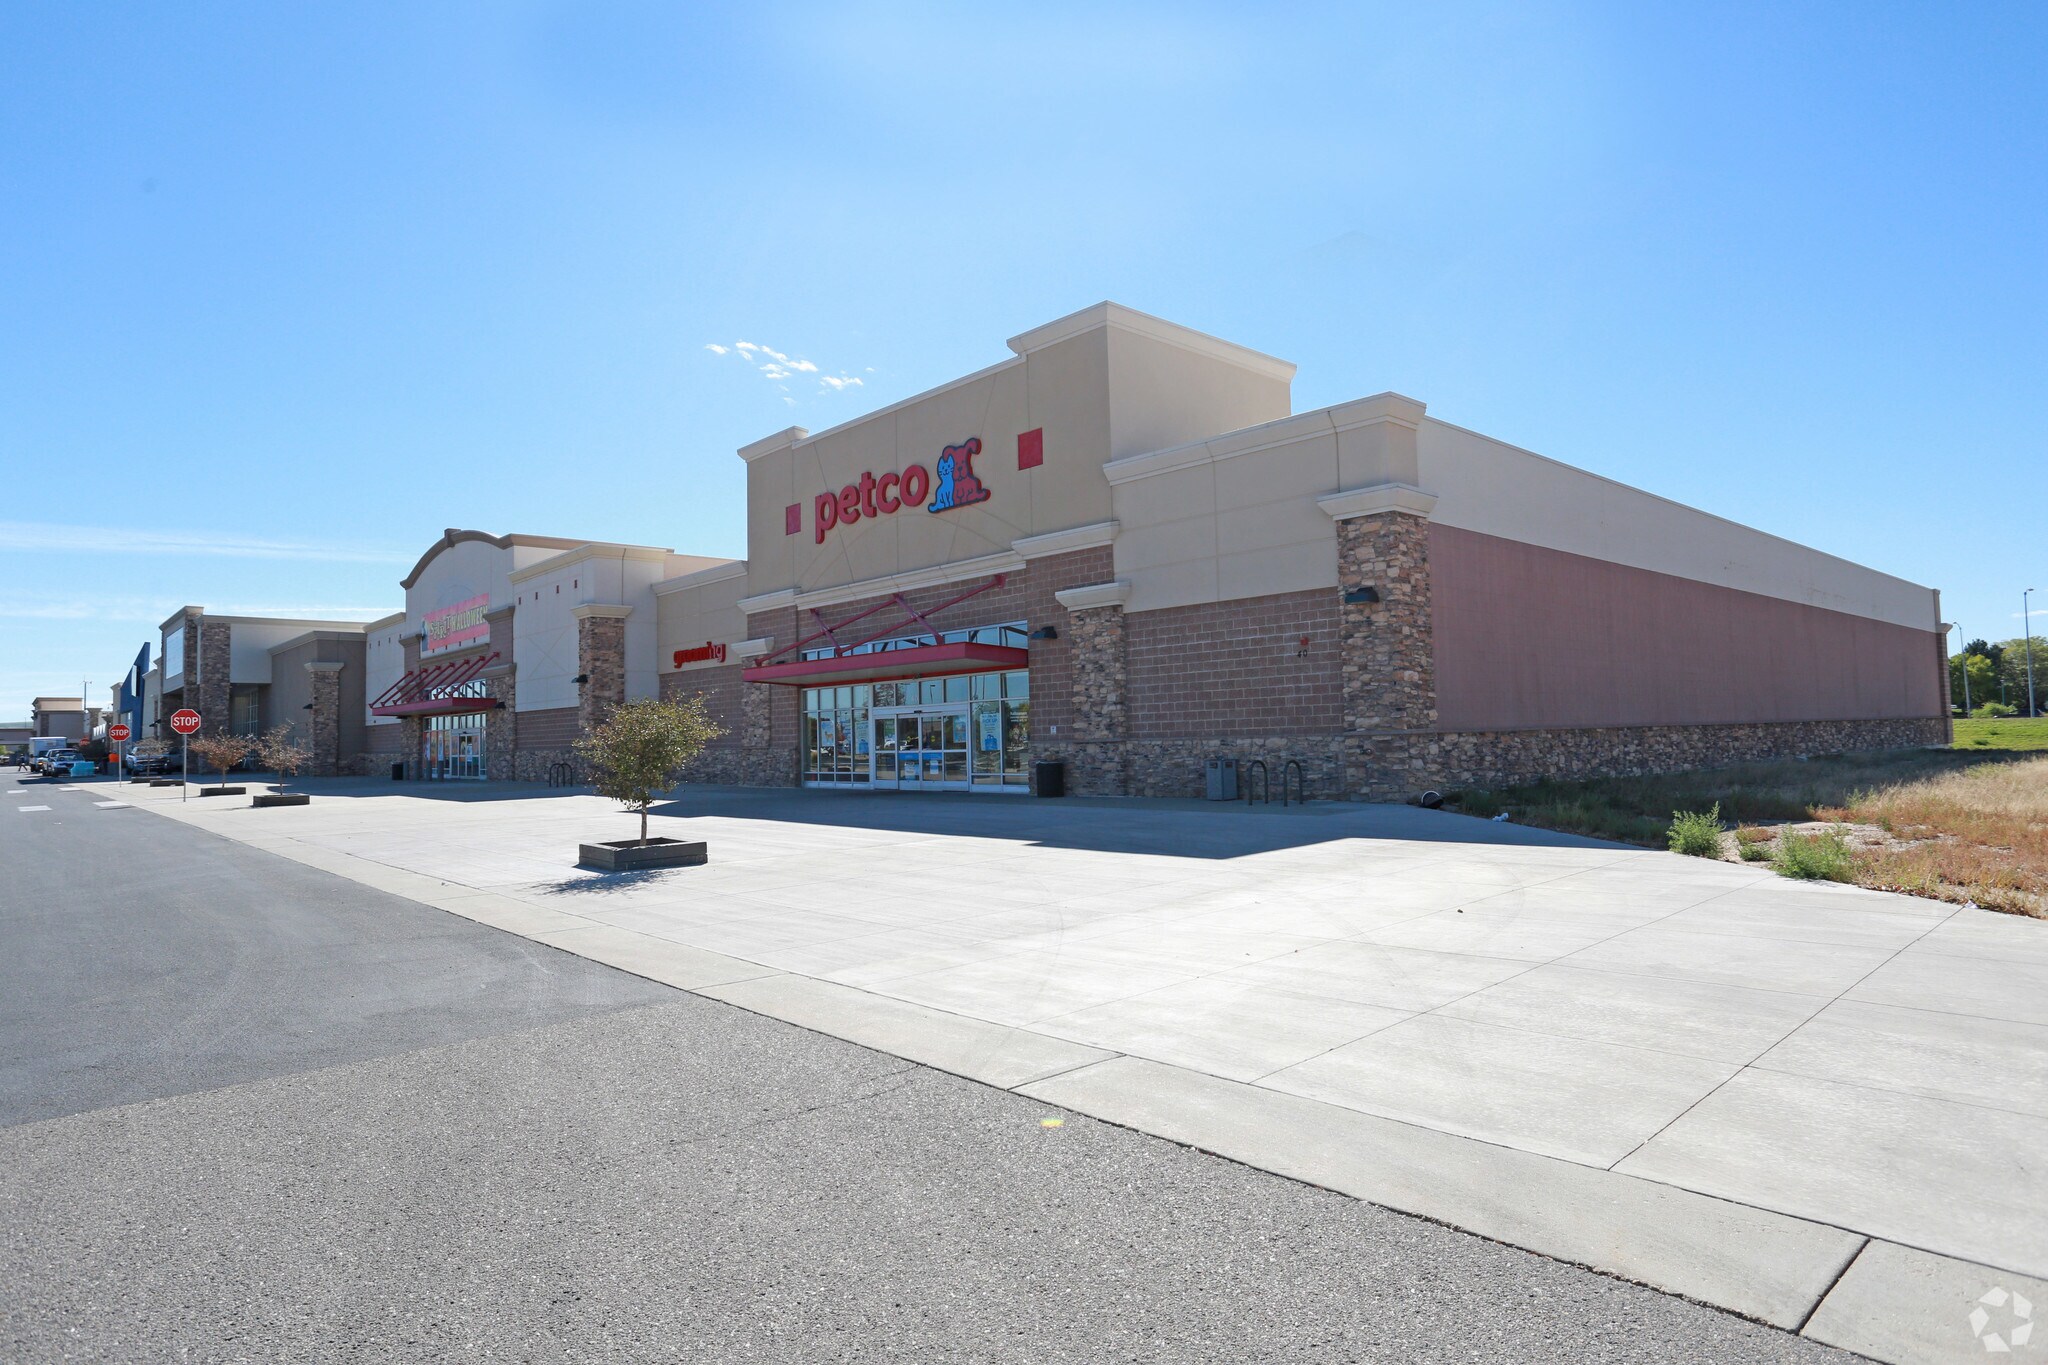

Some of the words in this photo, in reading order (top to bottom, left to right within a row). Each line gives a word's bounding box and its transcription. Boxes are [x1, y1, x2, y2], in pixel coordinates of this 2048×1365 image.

[815, 464, 929, 544] petco
[673, 641, 726, 669] grooming
[173, 717, 199, 726] STOP
